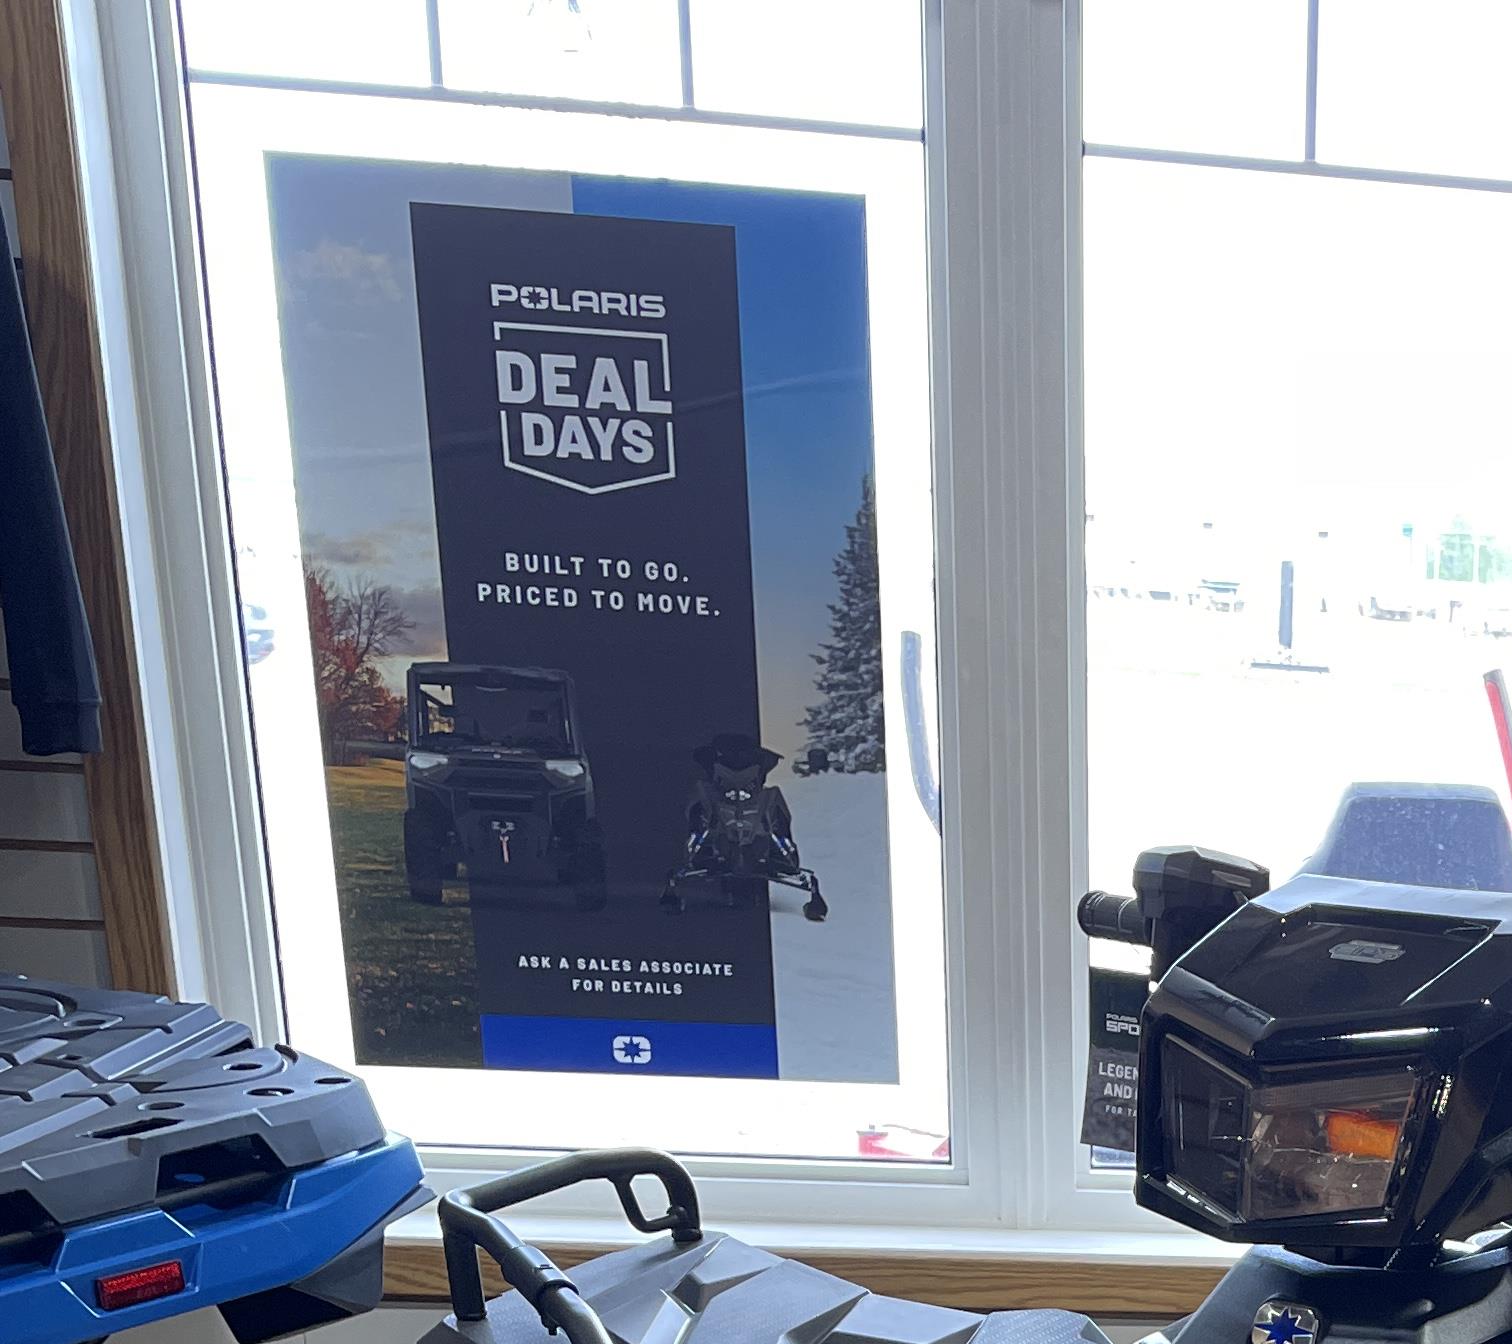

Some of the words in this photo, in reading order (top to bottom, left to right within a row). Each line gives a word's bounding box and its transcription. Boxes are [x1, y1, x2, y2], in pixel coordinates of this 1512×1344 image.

[490, 283, 666, 318] POLARIS
[495, 349, 673, 415] DEAL
[520, 411, 655, 464] DAYS
[504, 551, 585, 576] BUILT
[598, 558, 632, 579] TO
[643, 561, 690, 583] GO.
[476, 582, 579, 608] PRICED
[590, 589, 625, 611] TO
[636, 592, 721, 617] MOVE.
[517, 954, 552, 969] ASK
[558, 956, 570, 970] A
[576, 957, 633, 972] SALES
[639, 960, 734, 977] ASSOCIATE
[571, 978, 605, 992] FOR
[610, 979, 684, 996] DETAILS
[1106, 1020, 1140, 1035] SPO
[1099, 1061, 1138, 1080] LEGEN
[1104, 1082, 1132, 1099] AND
